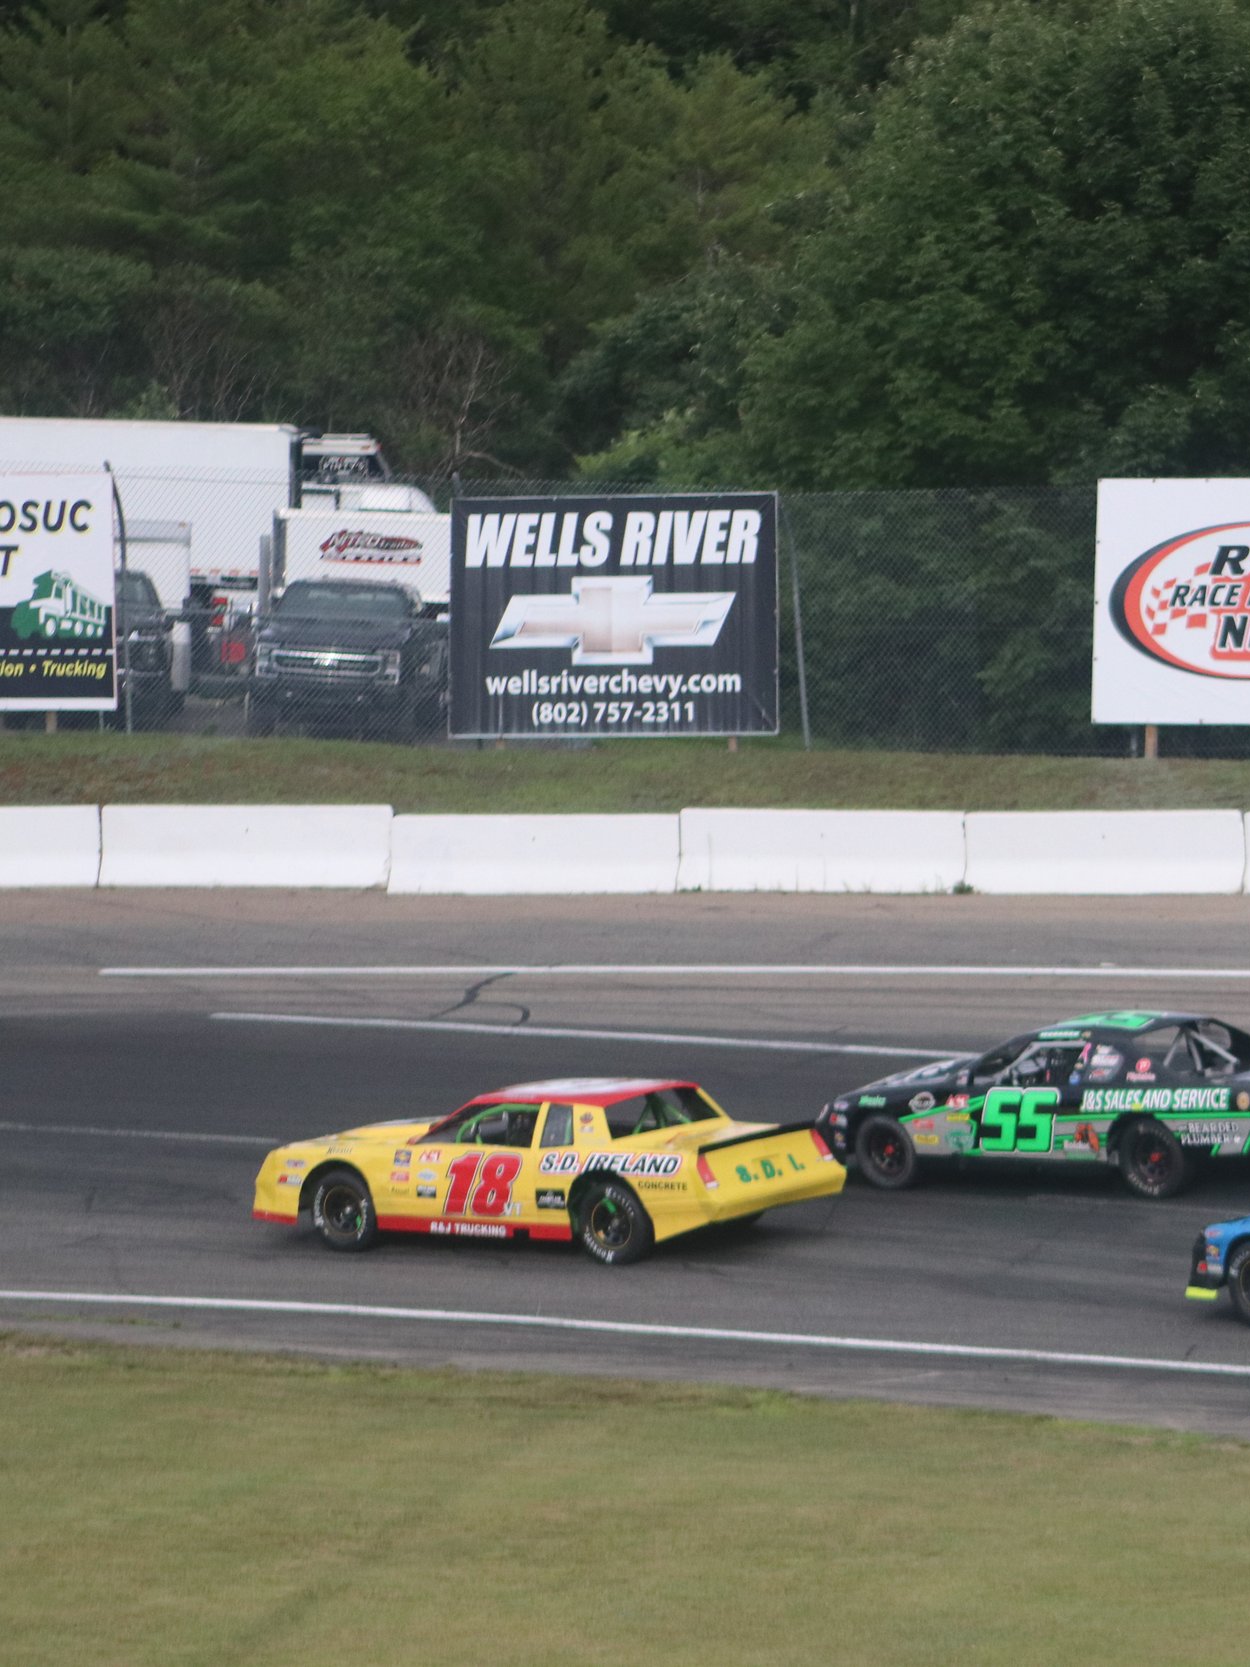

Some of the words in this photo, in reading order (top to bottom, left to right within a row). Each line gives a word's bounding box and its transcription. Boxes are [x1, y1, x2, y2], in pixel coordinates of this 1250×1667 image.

[465, 511, 613, 568] WELLS
[619, 509, 761, 566] RIVER
[1169, 583, 1242, 608] RACE
[42, 659, 107, 680] Trucking
[485, 669, 742, 699] wellsriverchevy.com
[532, 702, 588, 727] (802)
[593, 701, 695, 724] 757-2311
[1081, 1089, 1105, 1111] J&S
[1104, 1089, 1142, 1111] SALES
[1140, 1089, 1172, 1110] AND
[1172, 1088, 1228, 1109] SERVICE
[980, 1086, 1061, 1154] 55
[1181, 1133, 1230, 1145] PLUMBER
[541, 1151, 580, 1174] S.D.
[582, 1152, 682, 1176] IRELAND
[443, 1152, 523, 1216] 18
[638, 1180, 688, 1191] CONCRETE
[454, 1222, 507, 1237] TRUCKING
